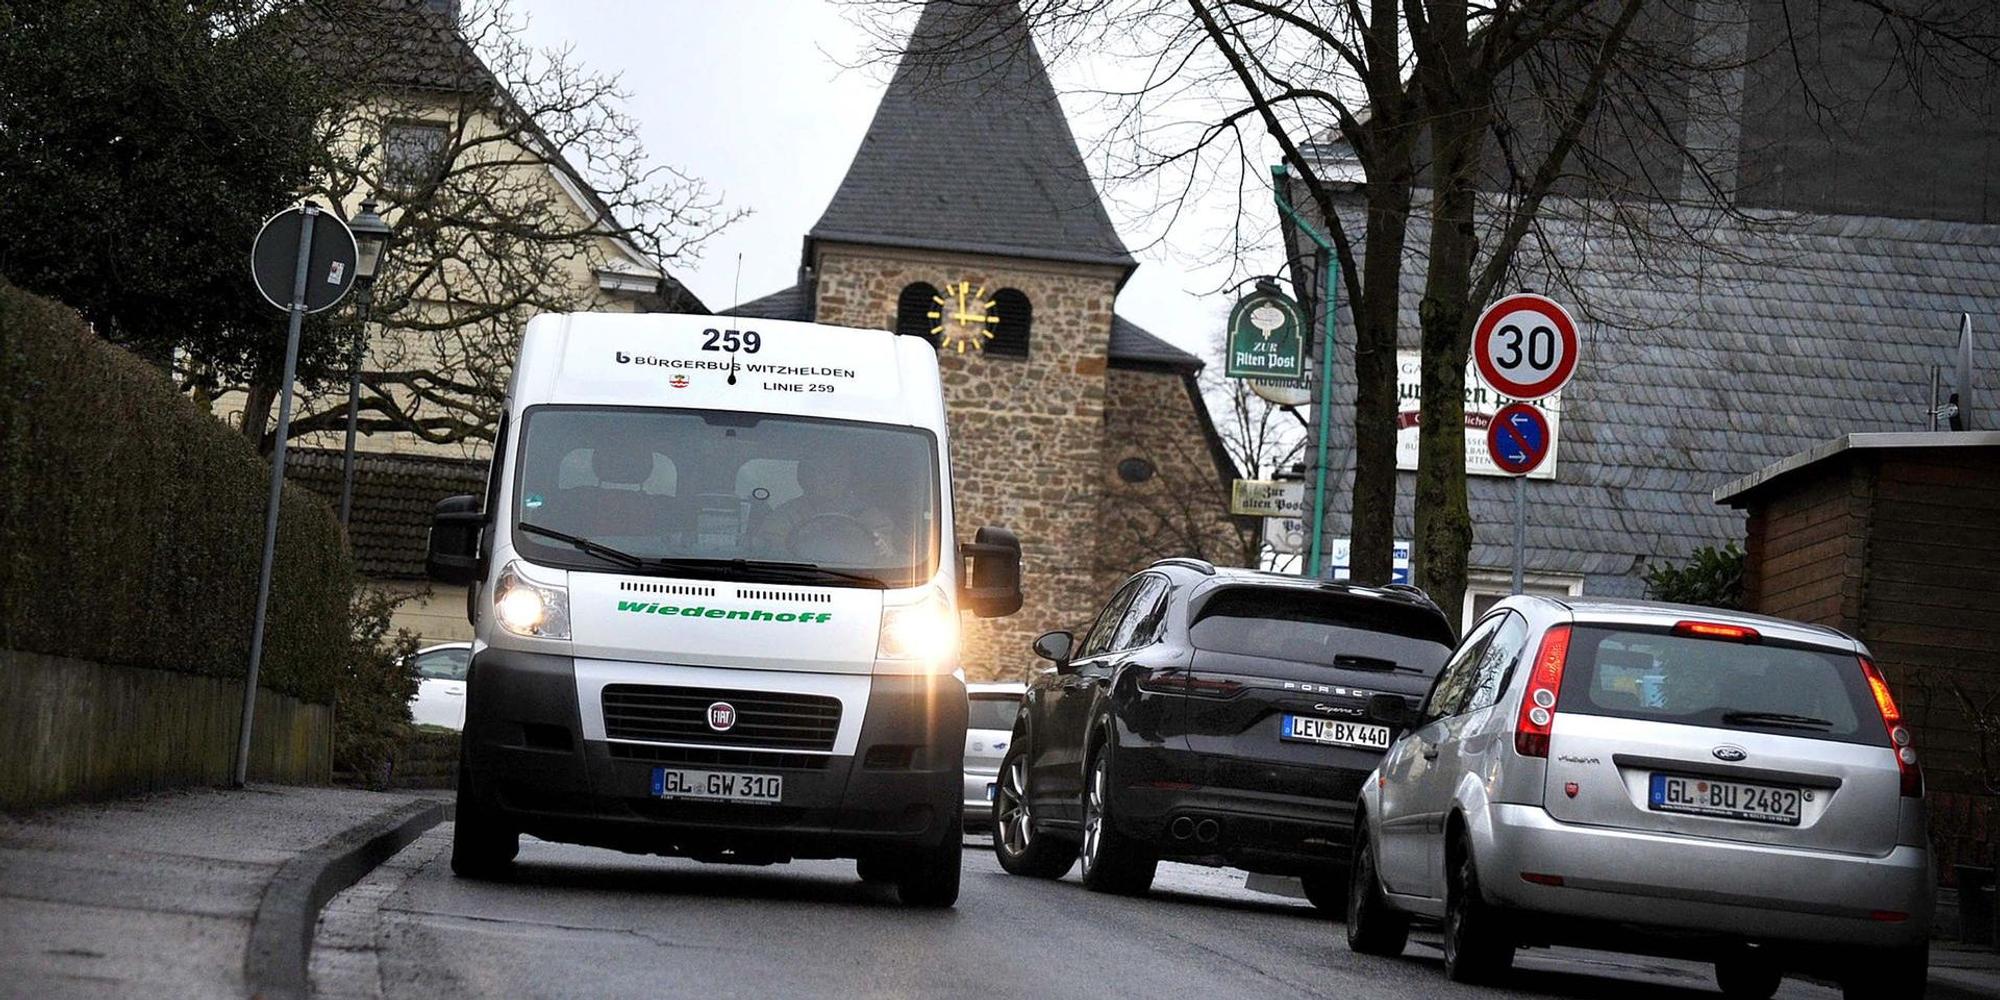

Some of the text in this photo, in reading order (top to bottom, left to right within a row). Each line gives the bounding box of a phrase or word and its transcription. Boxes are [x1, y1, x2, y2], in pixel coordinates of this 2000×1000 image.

[701, 328, 761, 354] 259
[1252, 342, 1278, 352] ZUR
[1496, 324, 1555, 371] 30
[634, 355, 741, 372] BÜRGERBUS
[746, 363, 856, 379] WITZHELDEN
[1236, 352, 1295, 369] Alten Post
[763, 381, 835, 394] LINIE 259
[1262, 486, 1285, 499] Zur
[1242, 498, 1271, 508] alten
[1282, 520, 1301, 533] Po
[617, 601, 832, 624] Wiedenhoff
[1284, 682, 1374, 697] PORSC
[713, 710, 730, 724] FIAT
[1293, 718, 1324, 737] LEV
[1335, 723, 1355, 742] BX
[1358, 727, 1387, 745] 440
[665, 772, 692, 793] GL
[707, 774, 735, 796] GW
[740, 776, 780, 798] 310
[1667, 781, 1694, 804] GL
[1710, 787, 1737, 810] BU
[1743, 790, 1796, 815] 2482
